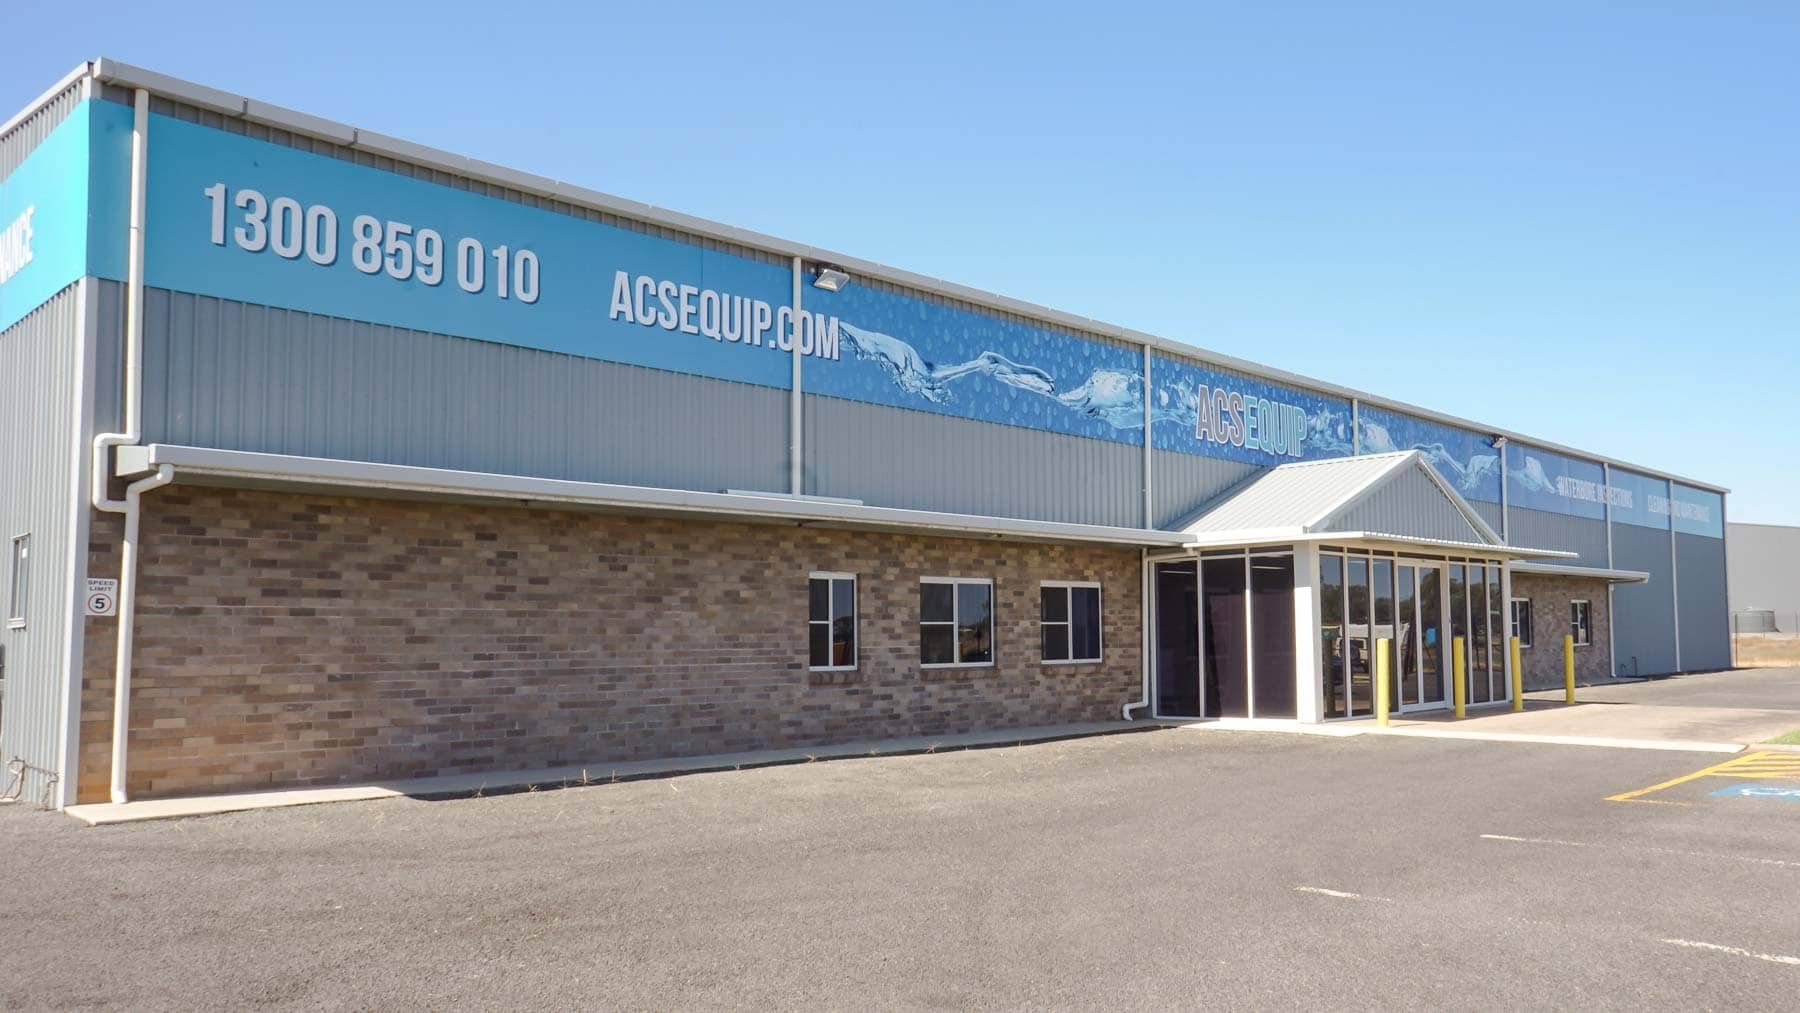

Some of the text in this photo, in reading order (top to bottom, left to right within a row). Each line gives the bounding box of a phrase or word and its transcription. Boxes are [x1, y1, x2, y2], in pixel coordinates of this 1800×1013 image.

[205, 182, 540, 304] 1300 859 010
[608, 270, 840, 361] ACSEQUIP.COM
[1196, 383, 1308, 458] ACSEQUIP
[95, 597, 105, 609] 5
